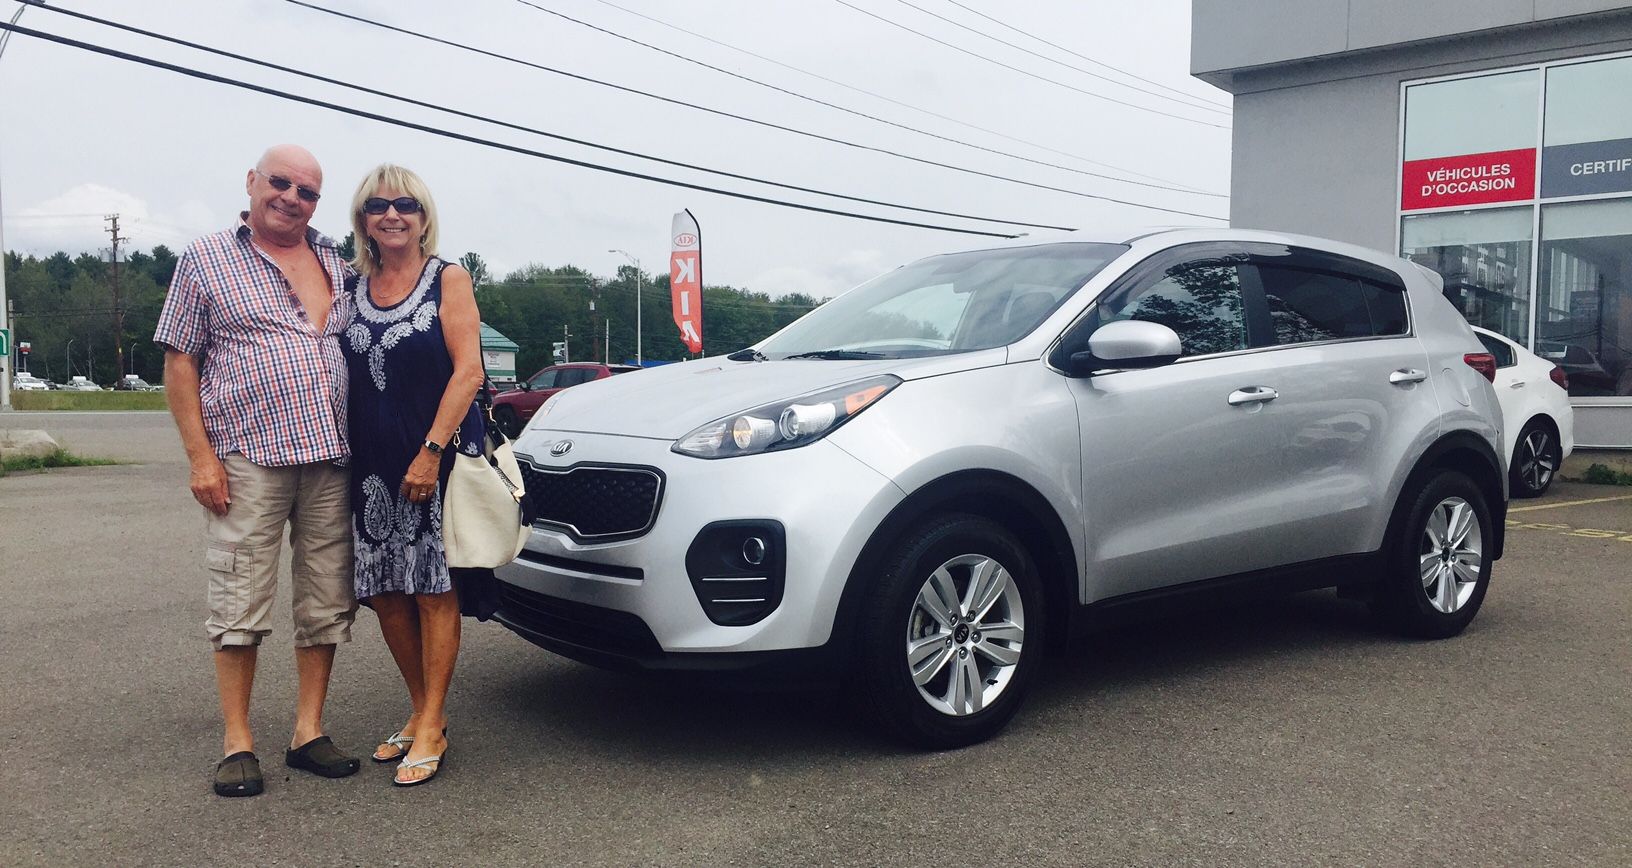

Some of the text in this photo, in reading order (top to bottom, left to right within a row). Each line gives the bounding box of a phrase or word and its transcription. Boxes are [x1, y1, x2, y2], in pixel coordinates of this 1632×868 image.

[1427, 163, 1511, 183] VÉHICULES
[1570, 158, 1632, 176] CERTIF
[1421, 177, 1515, 197] D'OCCASION
